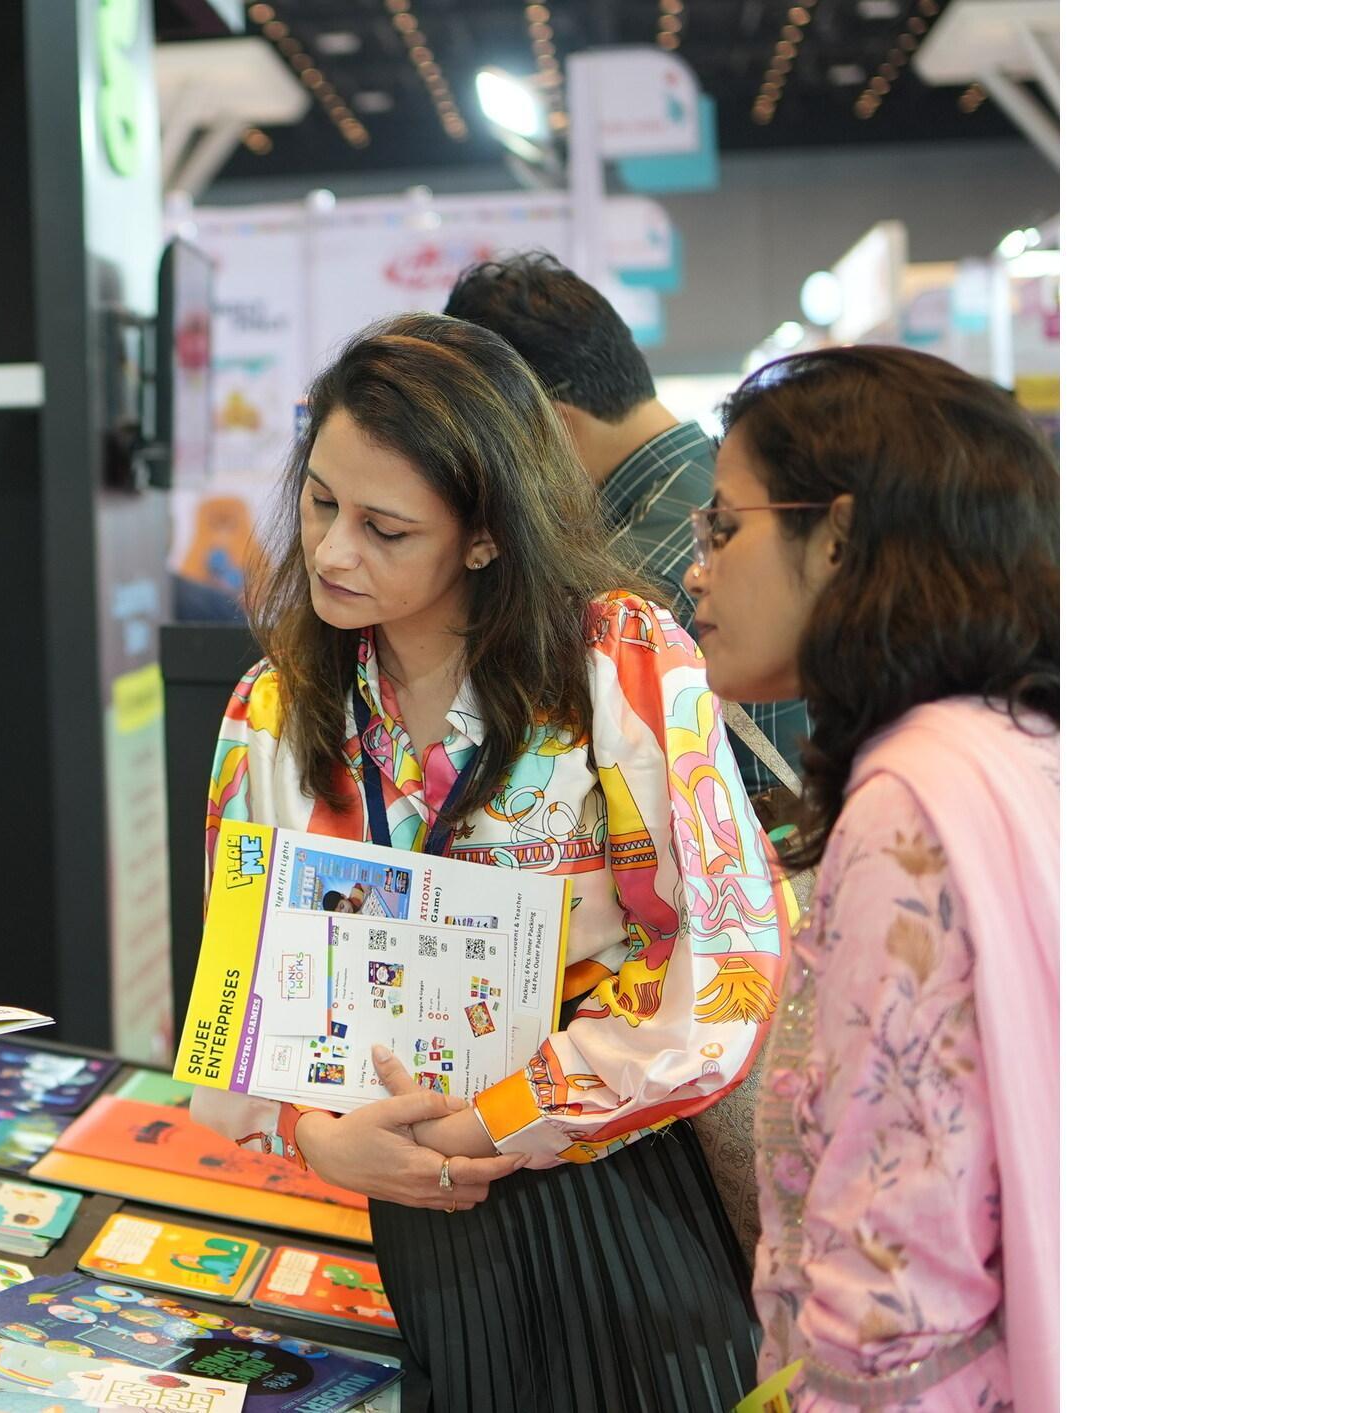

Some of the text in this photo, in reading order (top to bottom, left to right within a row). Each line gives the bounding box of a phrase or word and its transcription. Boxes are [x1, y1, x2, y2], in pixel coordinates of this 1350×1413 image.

[226, 834, 253, 889] PLAY
[240, 834, 265, 876] ME
[280, 840, 290, 867] Lights
[431, 886, 442, 923] Game)
[514, 892, 522, 921] Teacher
[536, 923, 544, 949] Packing
[522, 979, 531, 1004] Packing
[528, 911, 536, 937] Packing
[205, 969, 240, 1079] ENTERPRISES
[236, 998, 261, 1085] ELECTRO GAMES
[188, 1019, 212, 1075] SRIJEE
[294, 1373, 377, 1413] NURSERY
